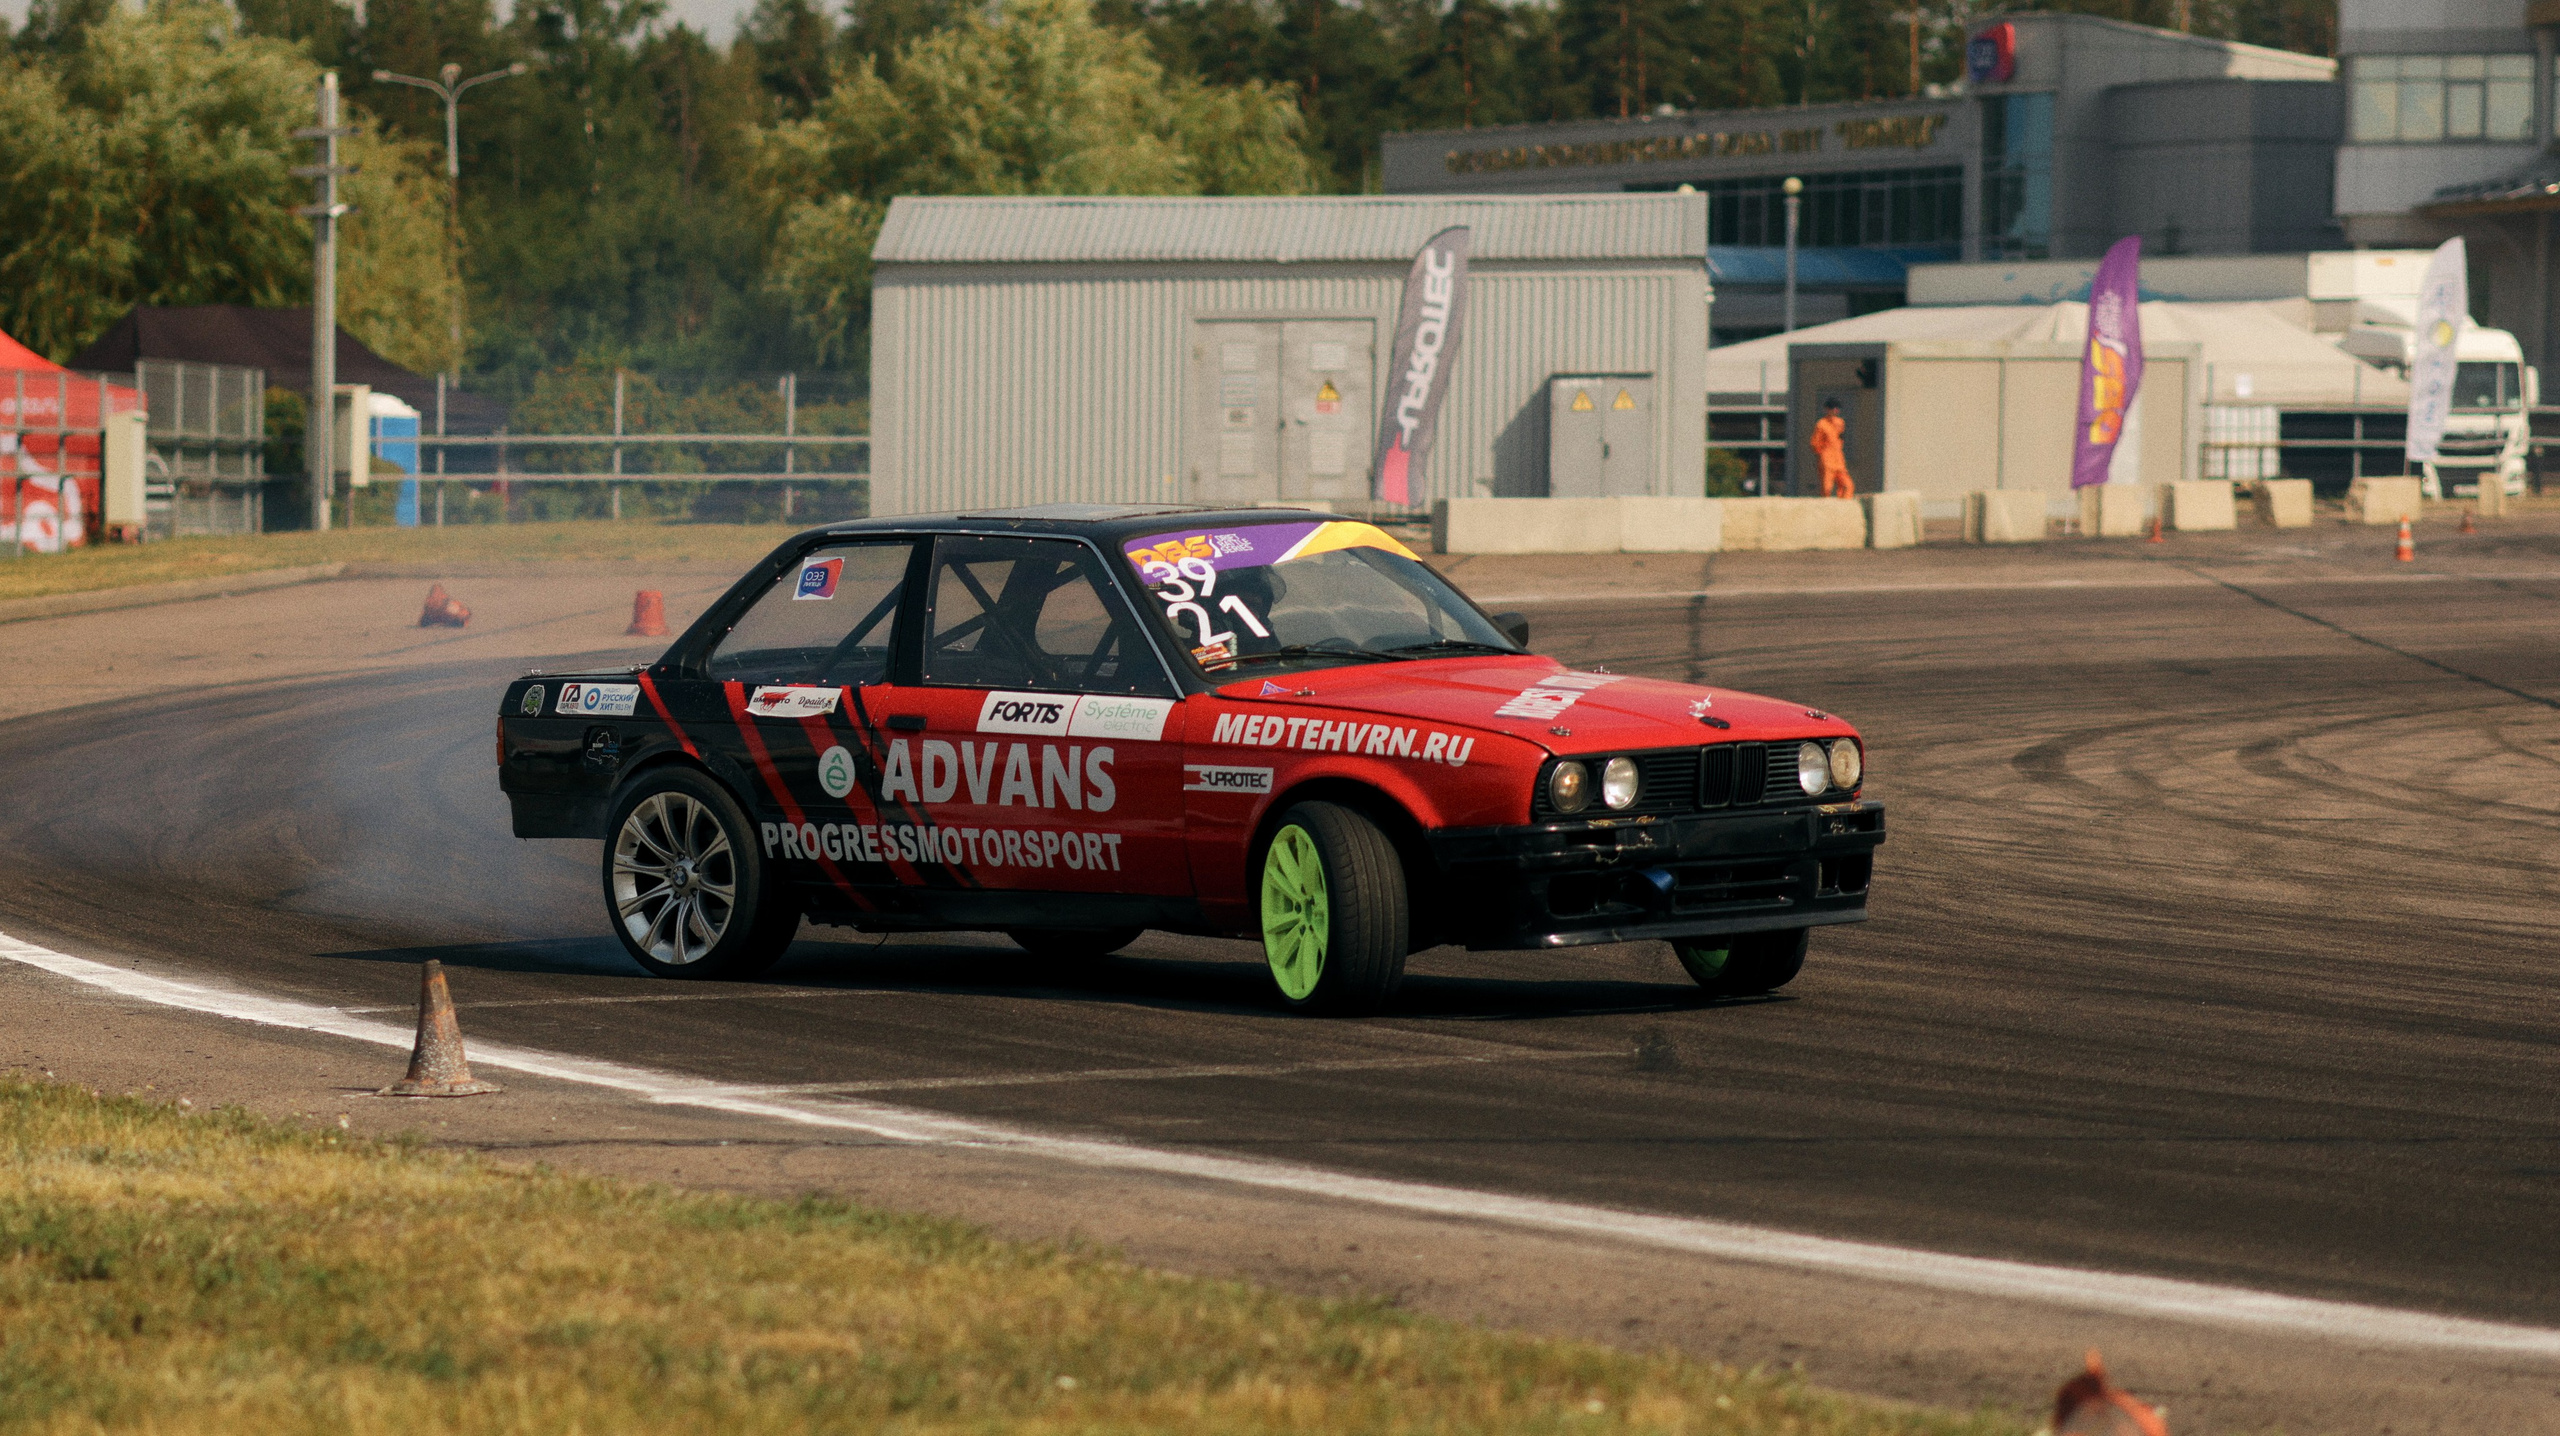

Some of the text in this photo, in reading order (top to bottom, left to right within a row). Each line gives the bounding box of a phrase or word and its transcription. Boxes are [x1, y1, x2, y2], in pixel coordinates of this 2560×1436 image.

[1143, 556, 1217, 602] 39
[1166, 595, 1270, 647] 21
[600, 703, 615, 711] ХИТ
[988, 701, 1065, 724] FORTIS
[1103, 717, 1154, 733] electric
[1212, 713, 1475, 767] MEDTEHVRN.RU
[881, 738, 1116, 812] ADVANS
[761, 822, 1123, 872] PROGRESSMOTORSPORT
